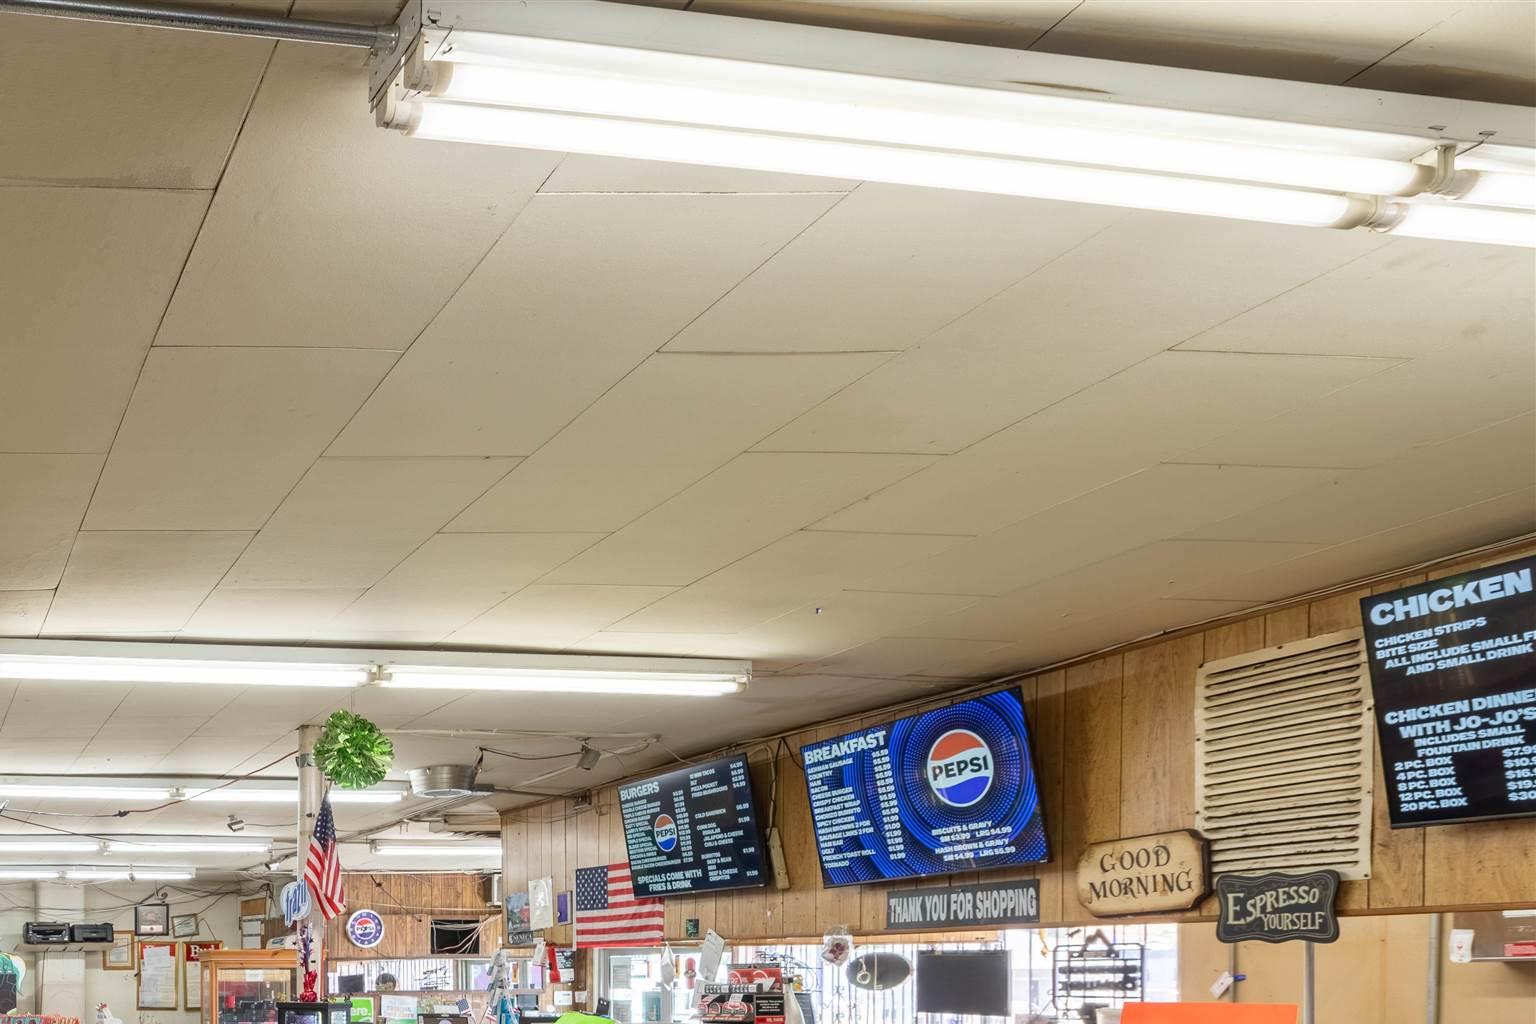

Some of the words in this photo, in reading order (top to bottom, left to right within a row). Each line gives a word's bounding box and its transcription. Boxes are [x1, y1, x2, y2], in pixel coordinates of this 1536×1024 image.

[1370, 568, 1533, 625] CHICKEN
[1374, 628, 1433, 648] CHICKEN
[1434, 616, 1487, 636] STRIPS
[1376, 645, 1407, 659] BITE
[1408, 639, 1440, 653] SIZE
[1385, 657, 1411, 670] ALL
[1412, 644, 1470, 664] INCLUDE
[1471, 634, 1523, 651] SMALL
[1405, 662, 1436, 676] AND
[1437, 653, 1486, 671] SMALL
[1486, 642, 1534, 661] DRINK
[1384, 699, 1470, 725] CHICKEN
[1471, 687, 1536, 711] DINNE
[1398, 720, 1451, 739] WITH
[1414, 731, 1477, 748] INCLUDES
[1478, 724, 1526, 738] SMALL
[805, 730, 886, 765] BREAKFAST
[1417, 741, 1481, 758] FOUNTAIN
[1482, 735, 1525, 749] DRINK
[932, 755, 989, 781] PEPSI
[1426, 755, 1453, 767] BOX
[809, 770, 833, 780] COUNTRY
[620, 781, 660, 801] BURGERS
[1398, 792, 1414, 802] 12
[1436, 787, 1463, 797] BOX
[1400, 802, 1418, 812] 20
[1440, 797, 1469, 808] BOX
[655, 827, 676, 839] PEPSI
[931, 825, 961, 836] BISCUITS
[968, 820, 993, 830] GRAVY
[975, 829, 990, 838] LRG
[990, 826, 1012, 836] $4.99
[845, 850, 861, 859] TOAST
[861, 849, 876, 857] ROLL
[935, 845, 952, 855] HASH
[985, 838, 1009, 848] GRAVY
[979, 848, 994, 857] LRG
[824, 860, 850, 869] TORNADO
[1100, 844, 1171, 873] GOOD
[637, 872, 668, 884] SPECIALS
[667, 870, 685, 881] COME
[685, 868, 703, 879] WITH
[649, 881, 667, 892] FRIES
[672, 879, 693, 890] DRINK
[1088, 868, 1193, 904] MORNING
[889, 896, 923, 924] THANK
[925, 894, 947, 921] YOU
[950, 891, 974, 920] FOR
[975, 887, 1037, 919] SHOPPING
[1227, 885, 1319, 925] ESPRESSO
[1263, 911, 1325, 931] YOURSELF
